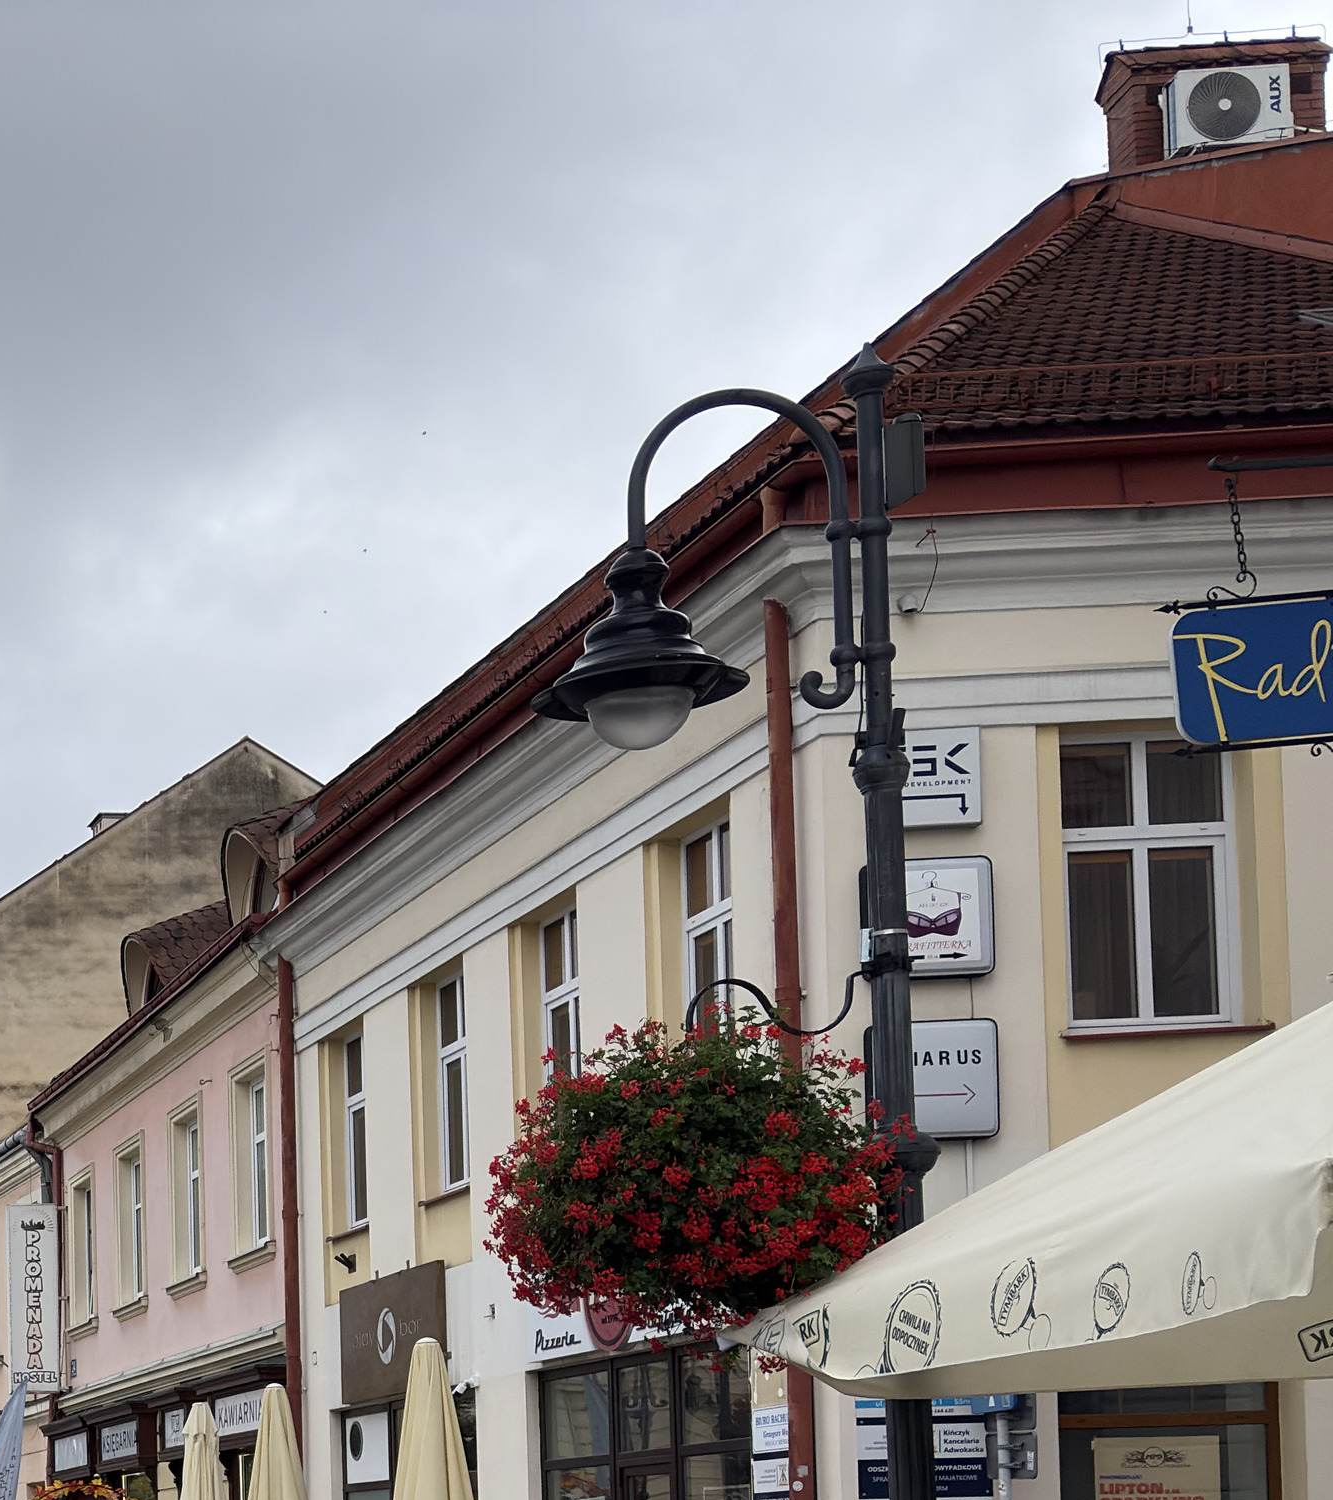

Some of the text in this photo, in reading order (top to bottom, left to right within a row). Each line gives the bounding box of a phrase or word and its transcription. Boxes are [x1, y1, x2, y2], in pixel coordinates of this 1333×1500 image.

[1269, 75, 1281, 113] AUX
[1173, 619, 1333, 742] Rad
[904, 779, 972, 788] DEVELOPMENT
[25, 1230, 43, 1369] PROMENADA
[1000, 1270, 1027, 1320] TYMBARK
[899, 1309, 931, 1335] CHWILA NA
[534, 1329, 581, 1353] Pizzeria
[892, 1326, 930, 1357] ODPOCZYNEK
[13, 1371, 58, 1384] HOSTEL
[102, 1427, 138, 1457] KSIĘGARNIA
[1100, 1483, 1163, 1495] LIPTON
